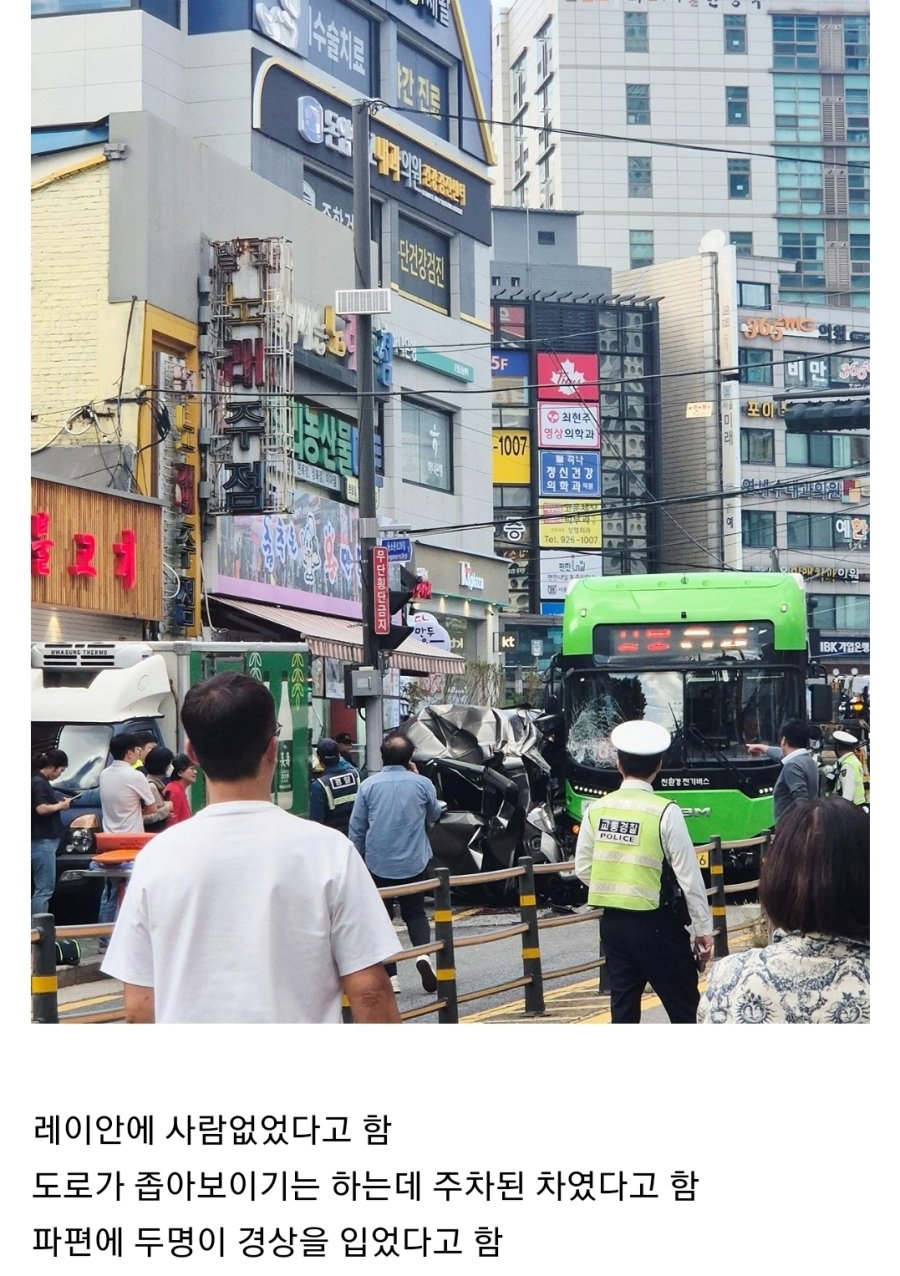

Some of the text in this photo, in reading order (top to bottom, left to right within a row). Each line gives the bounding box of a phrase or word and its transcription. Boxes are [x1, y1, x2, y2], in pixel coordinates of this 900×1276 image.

[417, 75, 441, 121] 진료
[818, 323, 847, 344] 의원
[788, 360, 828, 382] 비만
[222, 281, 265, 511] 노래주점
[562, 411, 591, 424] 최현주
[544, 428, 595, 440] 영상의학과
[547, 467, 594, 479] 정신건강
[547, 481, 581, 493] 의학과
[561, 536, 598, 544] 926-1007
[376, 549, 388, 630] 무단횡단금지
[502, 635, 515, 648] kt
[333, 775, 351, 787] 경찰
[661, 777, 710, 787] 친환경 전기버스
[600, 819, 639, 835] 교통경찰
[600, 832, 635, 843] POLICE
